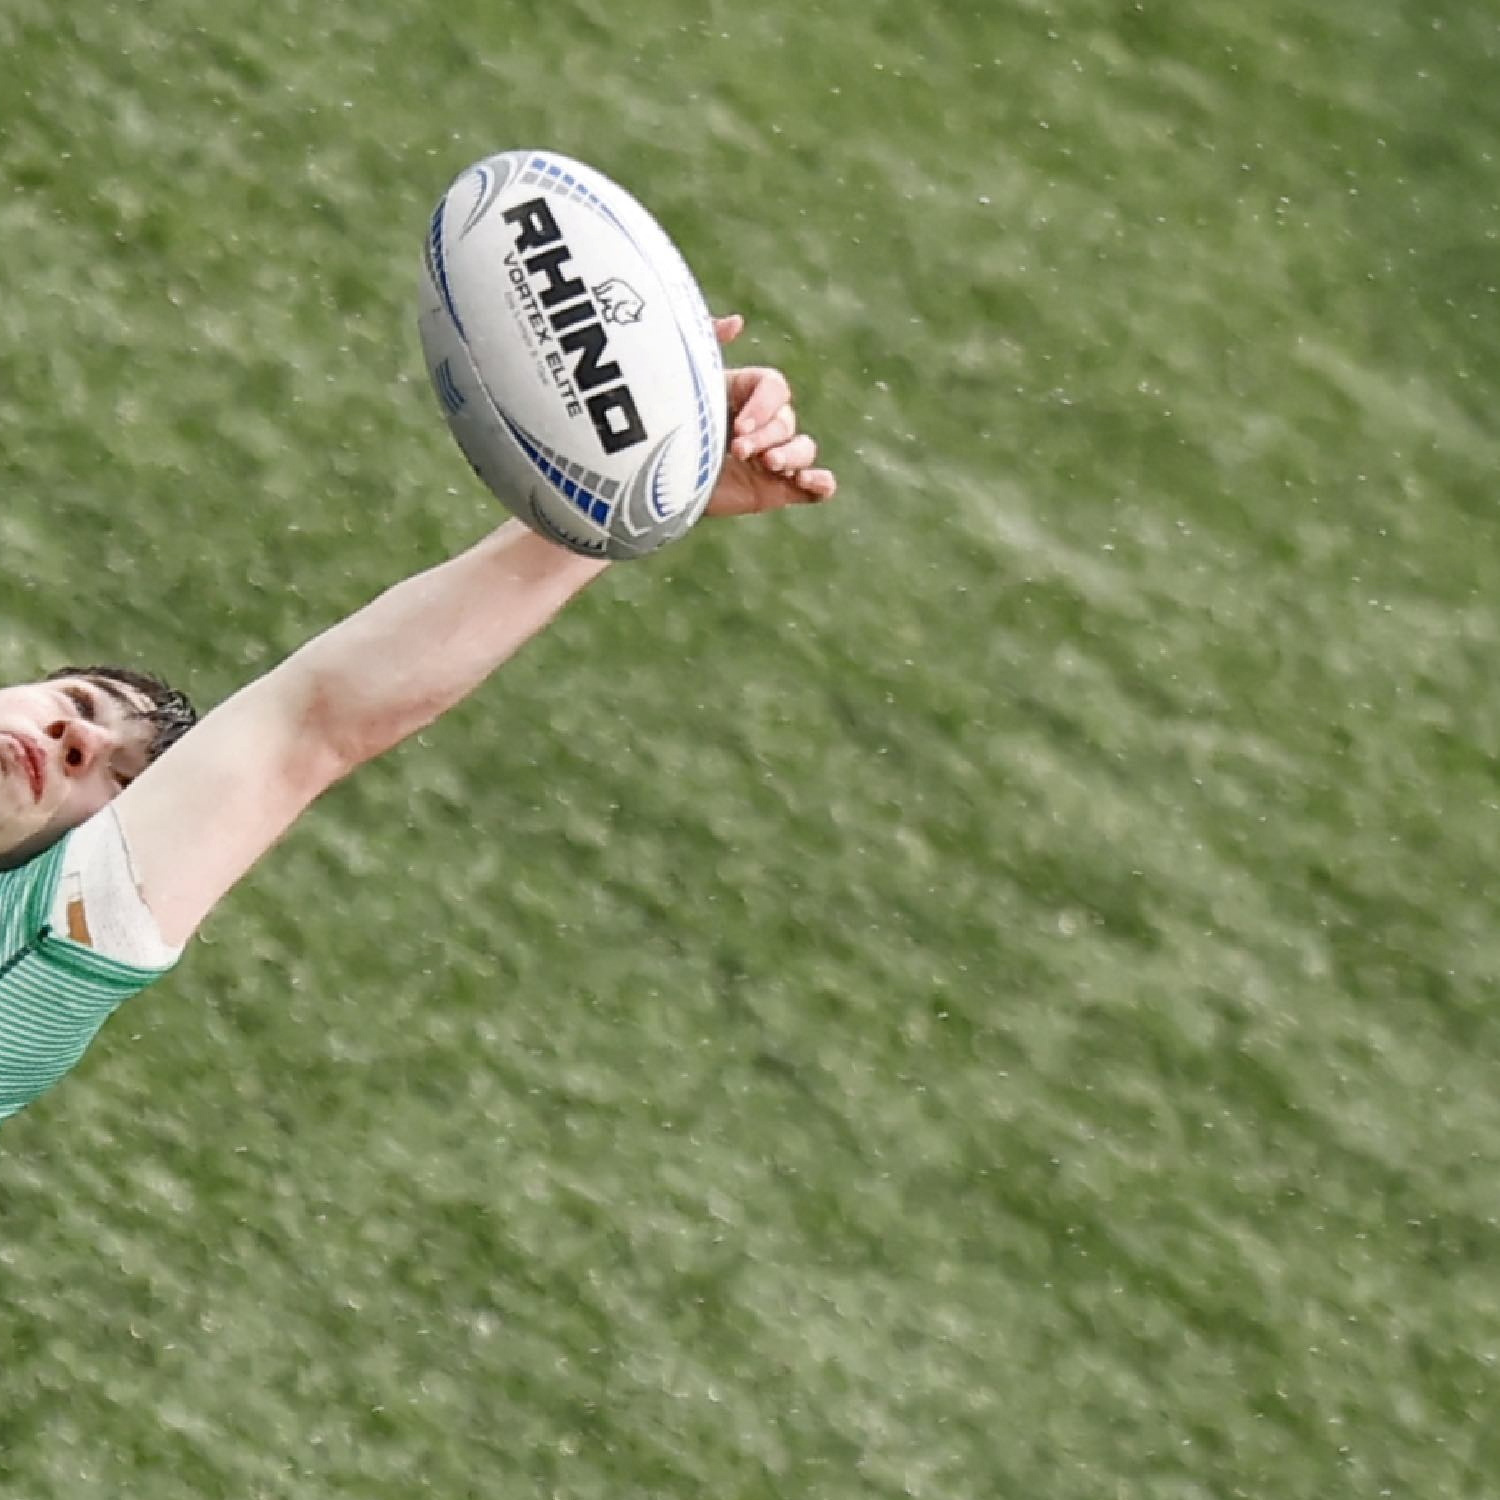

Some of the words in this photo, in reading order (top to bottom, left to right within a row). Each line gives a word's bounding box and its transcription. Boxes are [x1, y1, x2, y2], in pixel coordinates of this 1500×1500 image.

[502, 197, 648, 454] RHINO
[503, 250, 552, 345] VORTEX
[545, 350, 583, 418] ELITE
